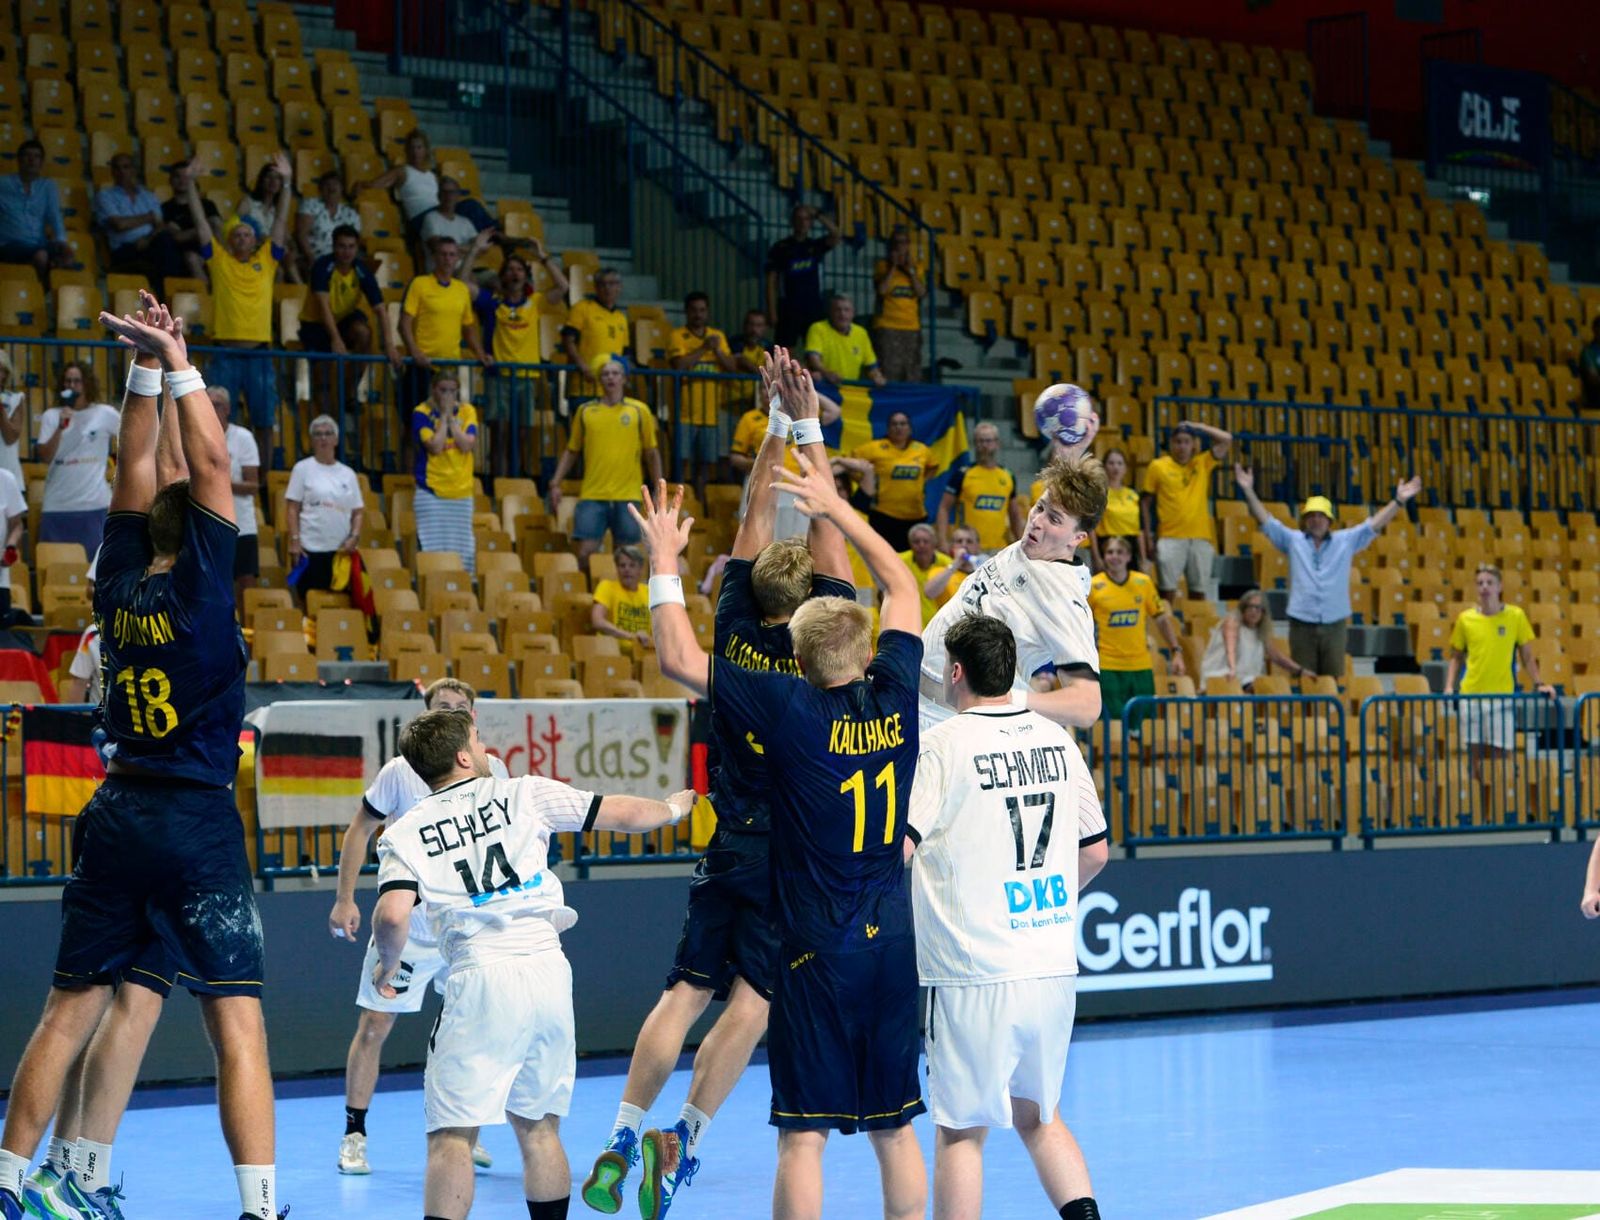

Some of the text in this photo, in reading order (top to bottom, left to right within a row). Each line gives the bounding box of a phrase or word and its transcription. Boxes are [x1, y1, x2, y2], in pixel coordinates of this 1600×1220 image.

[116, 665, 178, 739] 18
[575, 706, 680, 789] das!
[829, 712, 904, 756] KÄLLHAGE
[973, 745, 1068, 791] SCHMIDT
[418, 798, 512, 858] SCHLEY
[840, 761, 896, 853] 11
[1005, 791, 1055, 871] 17
[453, 842, 521, 895] 14
[1003, 874, 1068, 914] DKB
[1076, 888, 1271, 972] Gerflor
[261, 1178, 269, 1205] CRAFT
